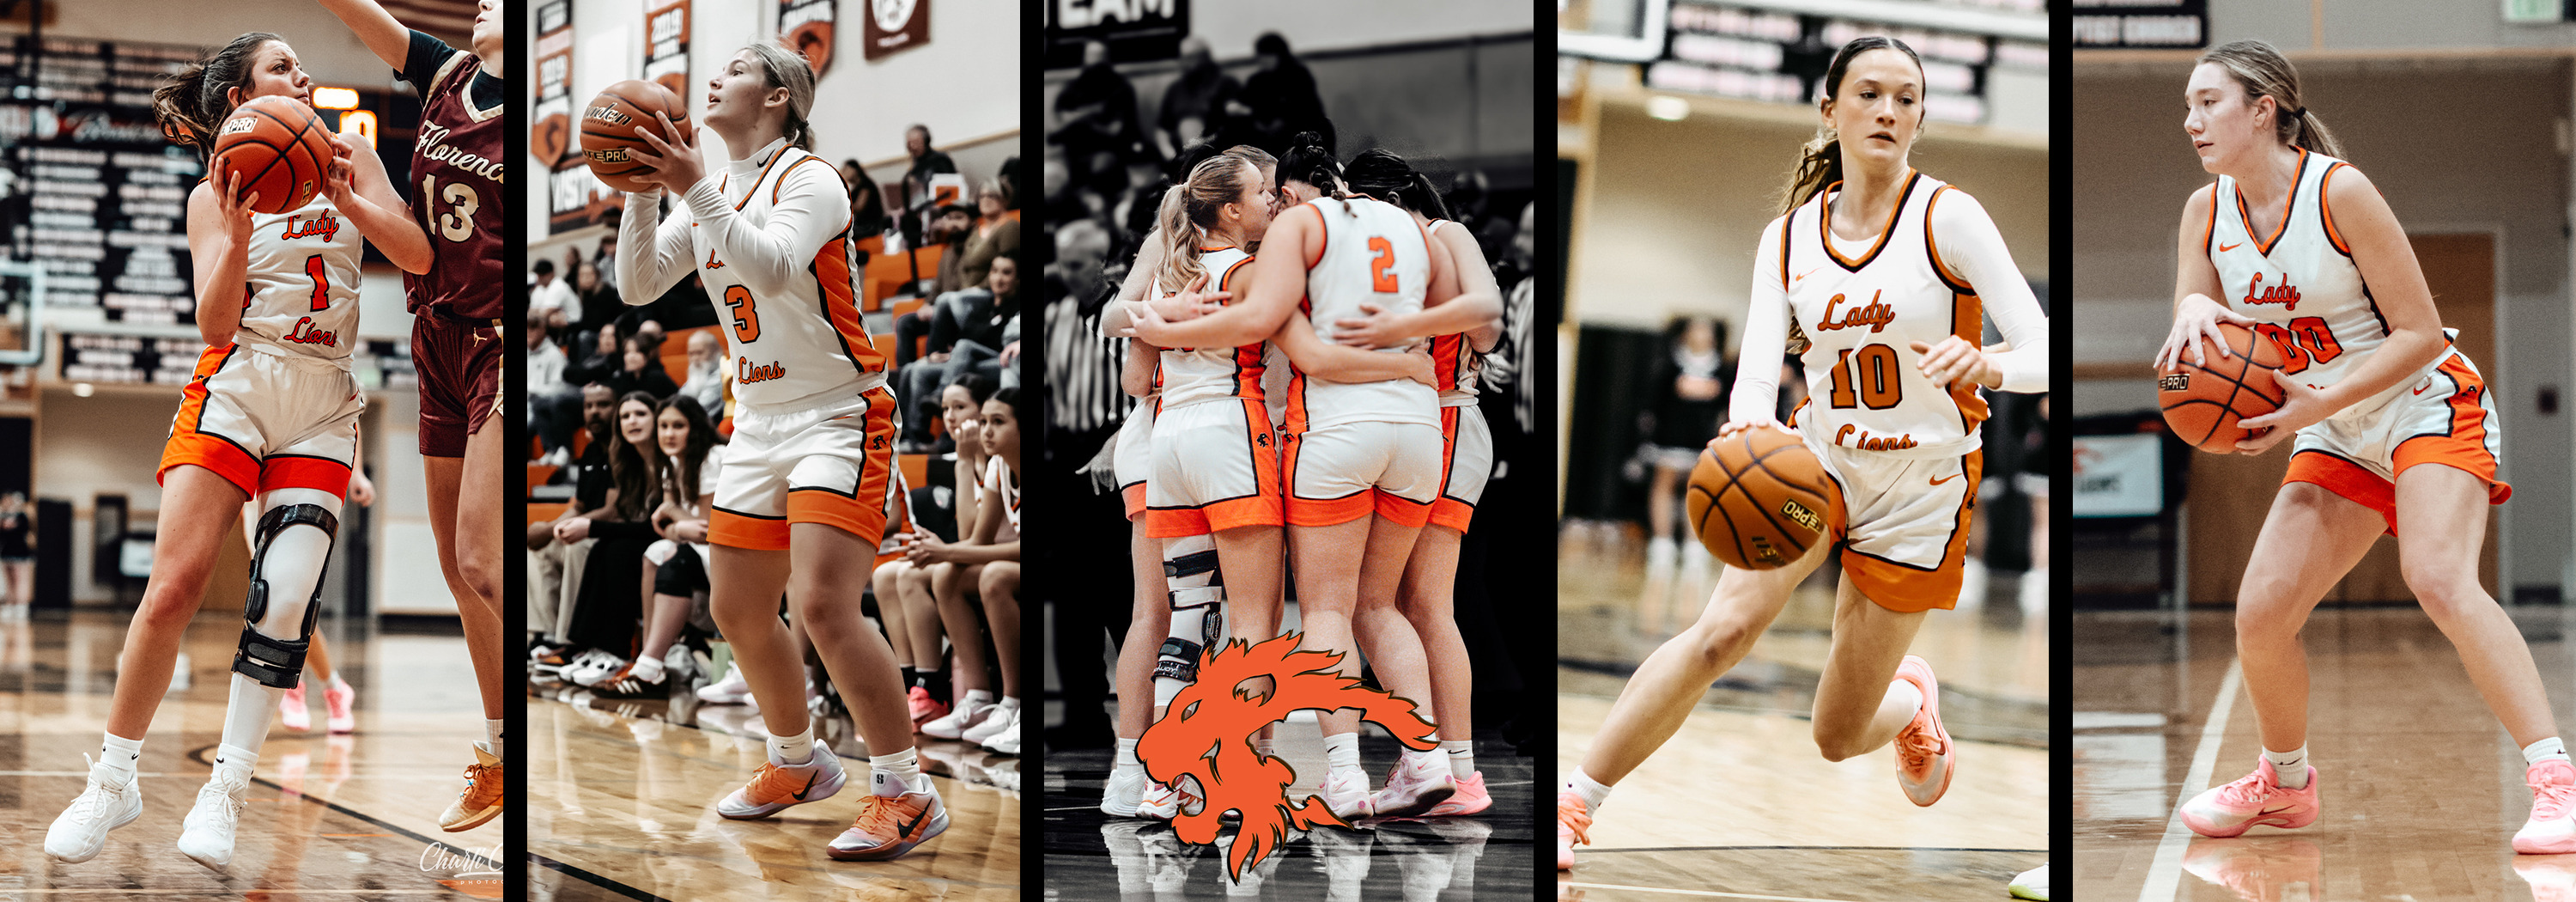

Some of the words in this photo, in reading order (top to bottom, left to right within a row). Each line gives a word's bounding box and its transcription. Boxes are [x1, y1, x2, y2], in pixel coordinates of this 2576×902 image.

[282, 208, 339, 242] Lady
[422, 173, 479, 242] 13
[305, 253, 331, 312] 1
[1368, 236, 1399, 293] 2
[2244, 272, 2301, 311] Lady
[724, 284, 761, 344] 3
[1817, 289, 1896, 333] Lady
[738, 356, 786, 385] Lions
[1830, 343, 1903, 411] 10
